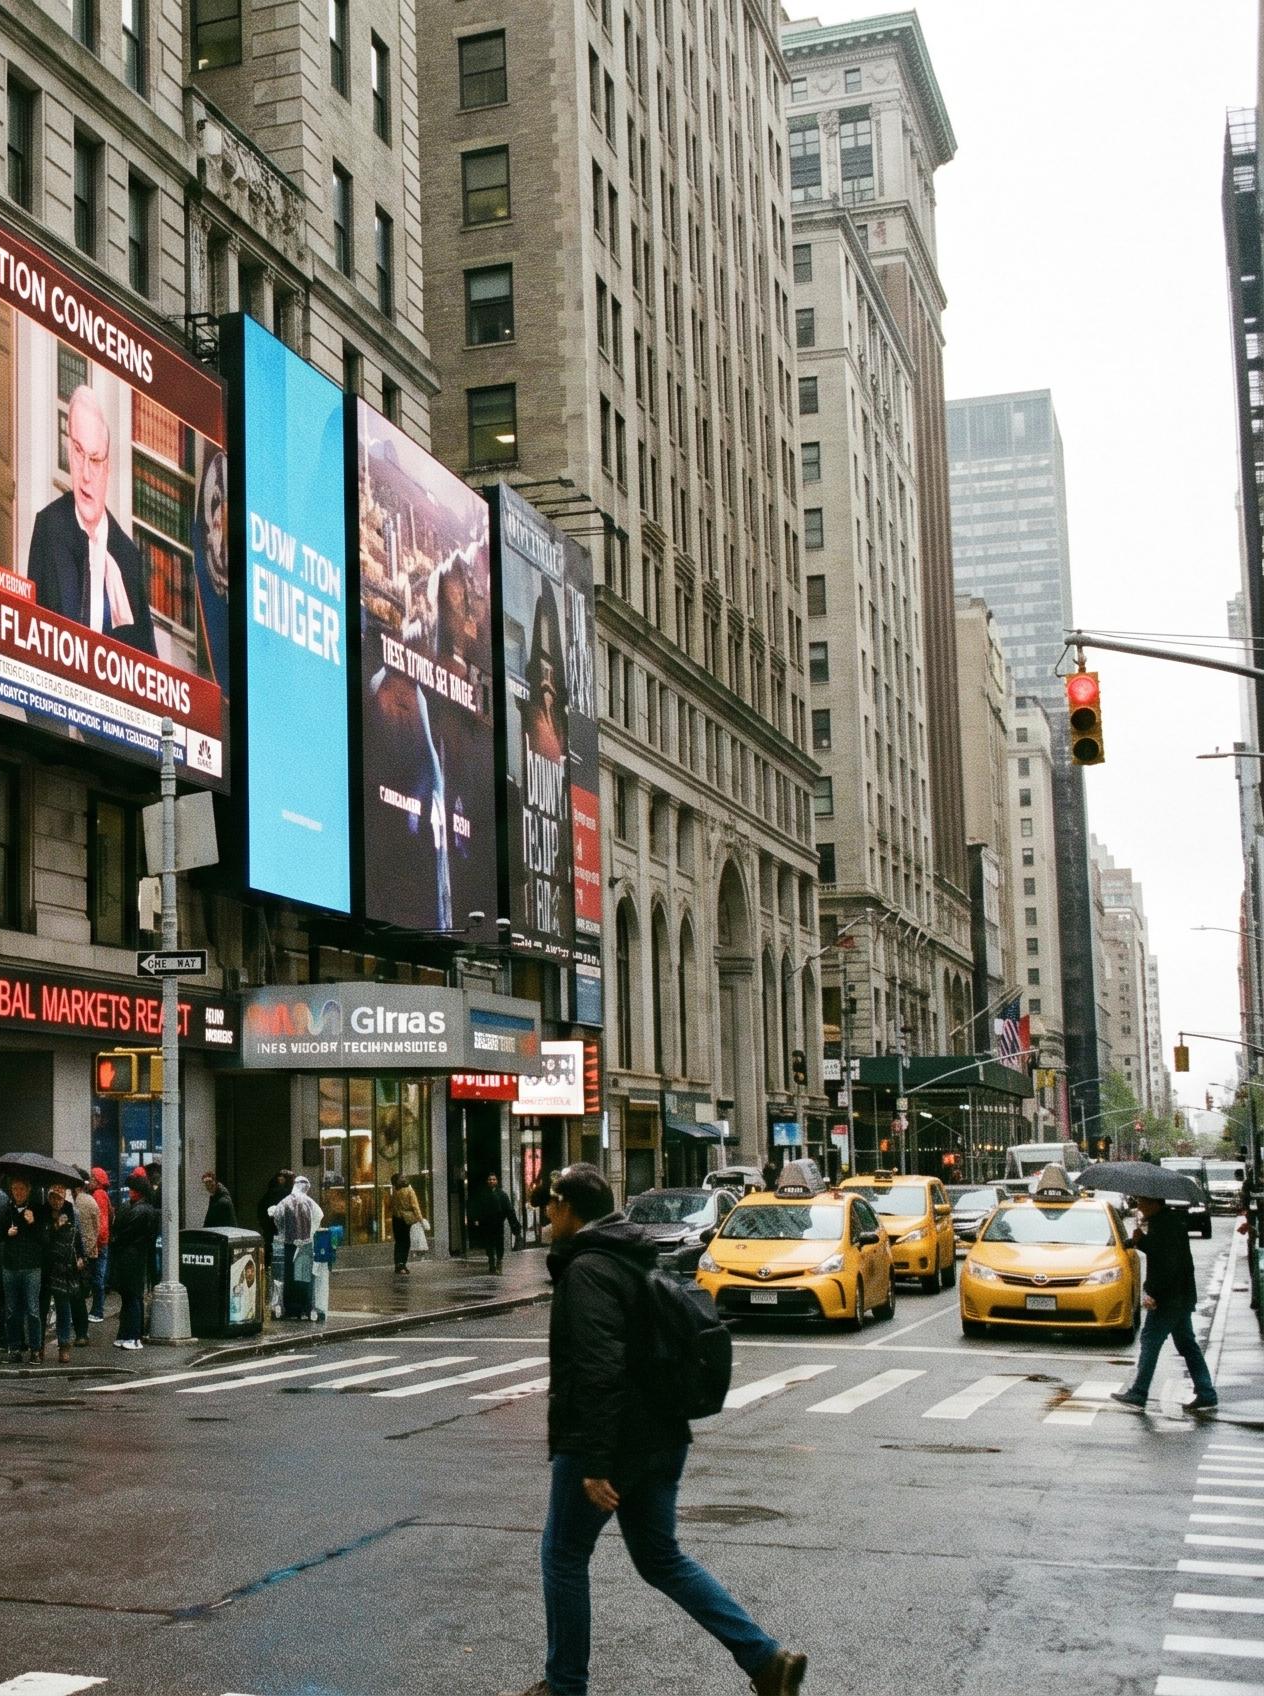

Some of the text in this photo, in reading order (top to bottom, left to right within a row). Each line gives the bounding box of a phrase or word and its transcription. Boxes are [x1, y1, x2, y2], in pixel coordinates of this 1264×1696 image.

[52, 286, 154, 384] CONCERNS
[94, 646, 190, 714] CONCERNS
[42, 985, 130, 1030] MARKETS
